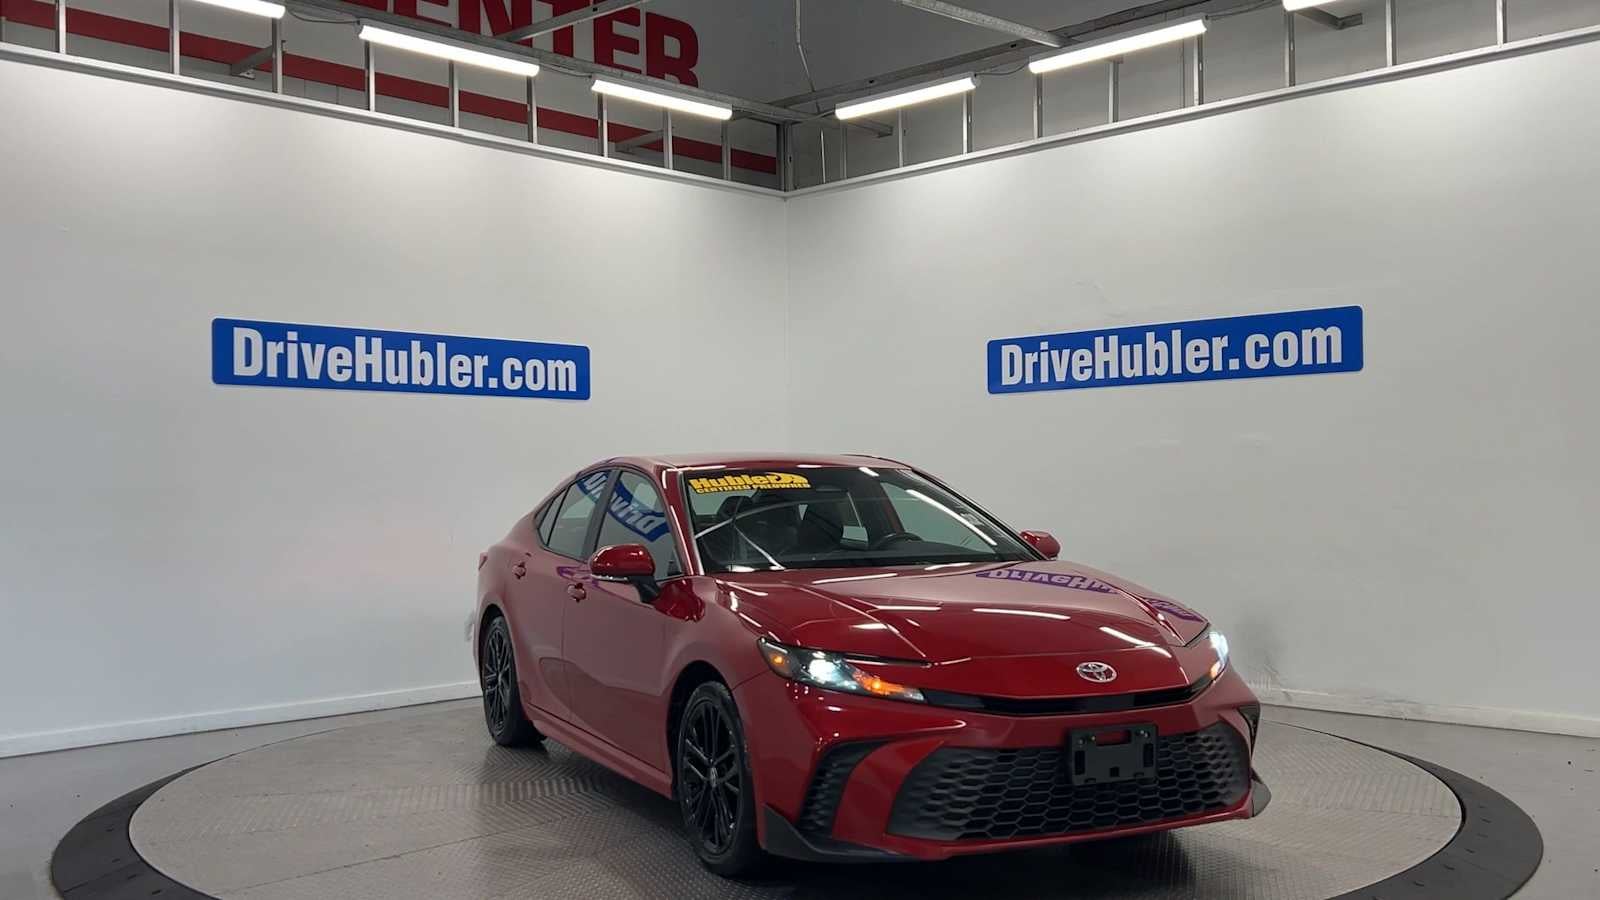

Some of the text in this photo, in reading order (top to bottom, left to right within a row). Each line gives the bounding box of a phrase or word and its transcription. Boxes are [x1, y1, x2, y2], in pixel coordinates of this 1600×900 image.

[341, 0, 699, 89] ENTER
[232, 326, 578, 392] DriveHubler.com
[1000, 325, 1342, 386] DriveHubler.com
